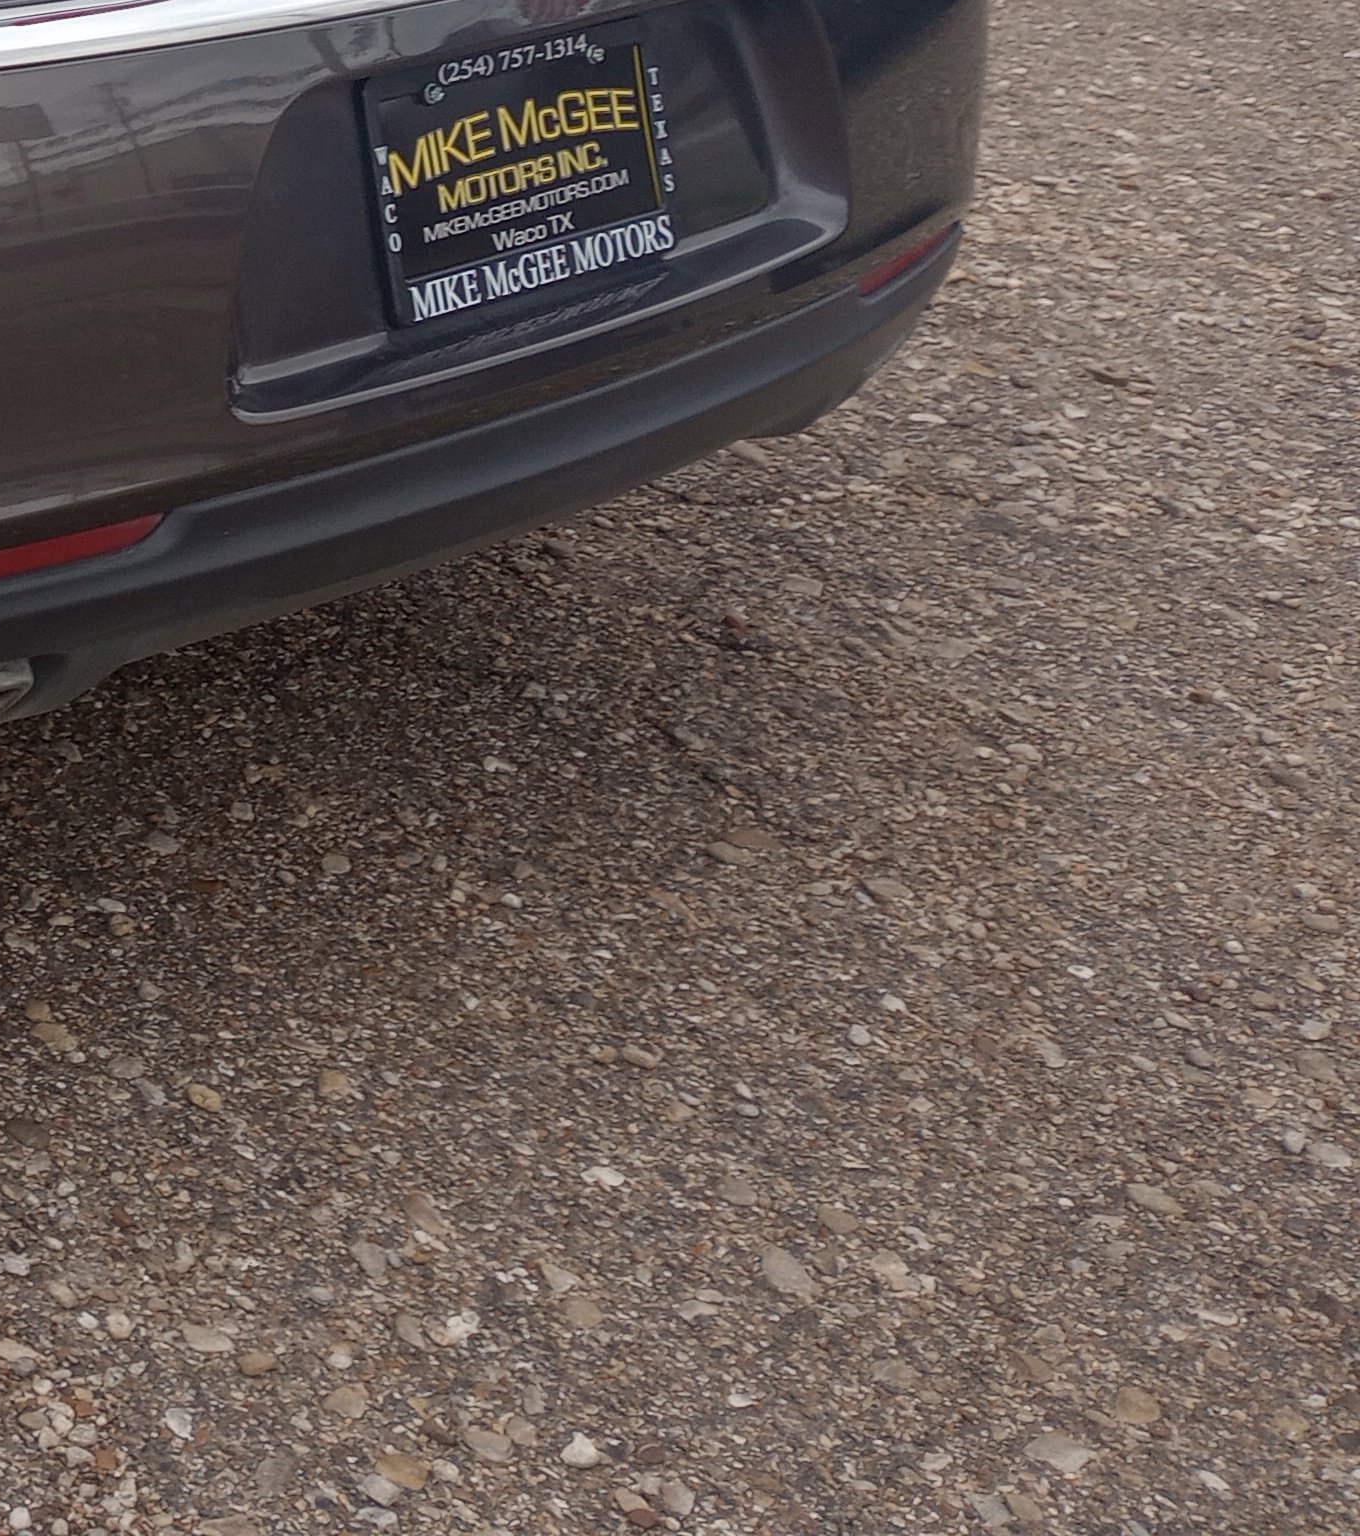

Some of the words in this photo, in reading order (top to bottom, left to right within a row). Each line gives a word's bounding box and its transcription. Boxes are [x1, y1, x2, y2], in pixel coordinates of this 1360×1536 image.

[438, 54, 494, 86] (254)
[498, 33, 588, 70] 757-1314
[388, 111, 496, 198] MIKE
[497, 86, 641, 153] McGEE
[437, 152, 558, 214] MOTORS
[556, 140, 609, 181] INC.
[647, 67, 676, 193] TEXAS
[373, 145, 403, 254] WACO
[492, 224, 548, 252] Waco
[547, 211, 576, 237] TX
[407, 270, 482, 323] MIKE
[481, 244, 570, 301] McGEE
[572, 214, 676, 276] MOTORS
